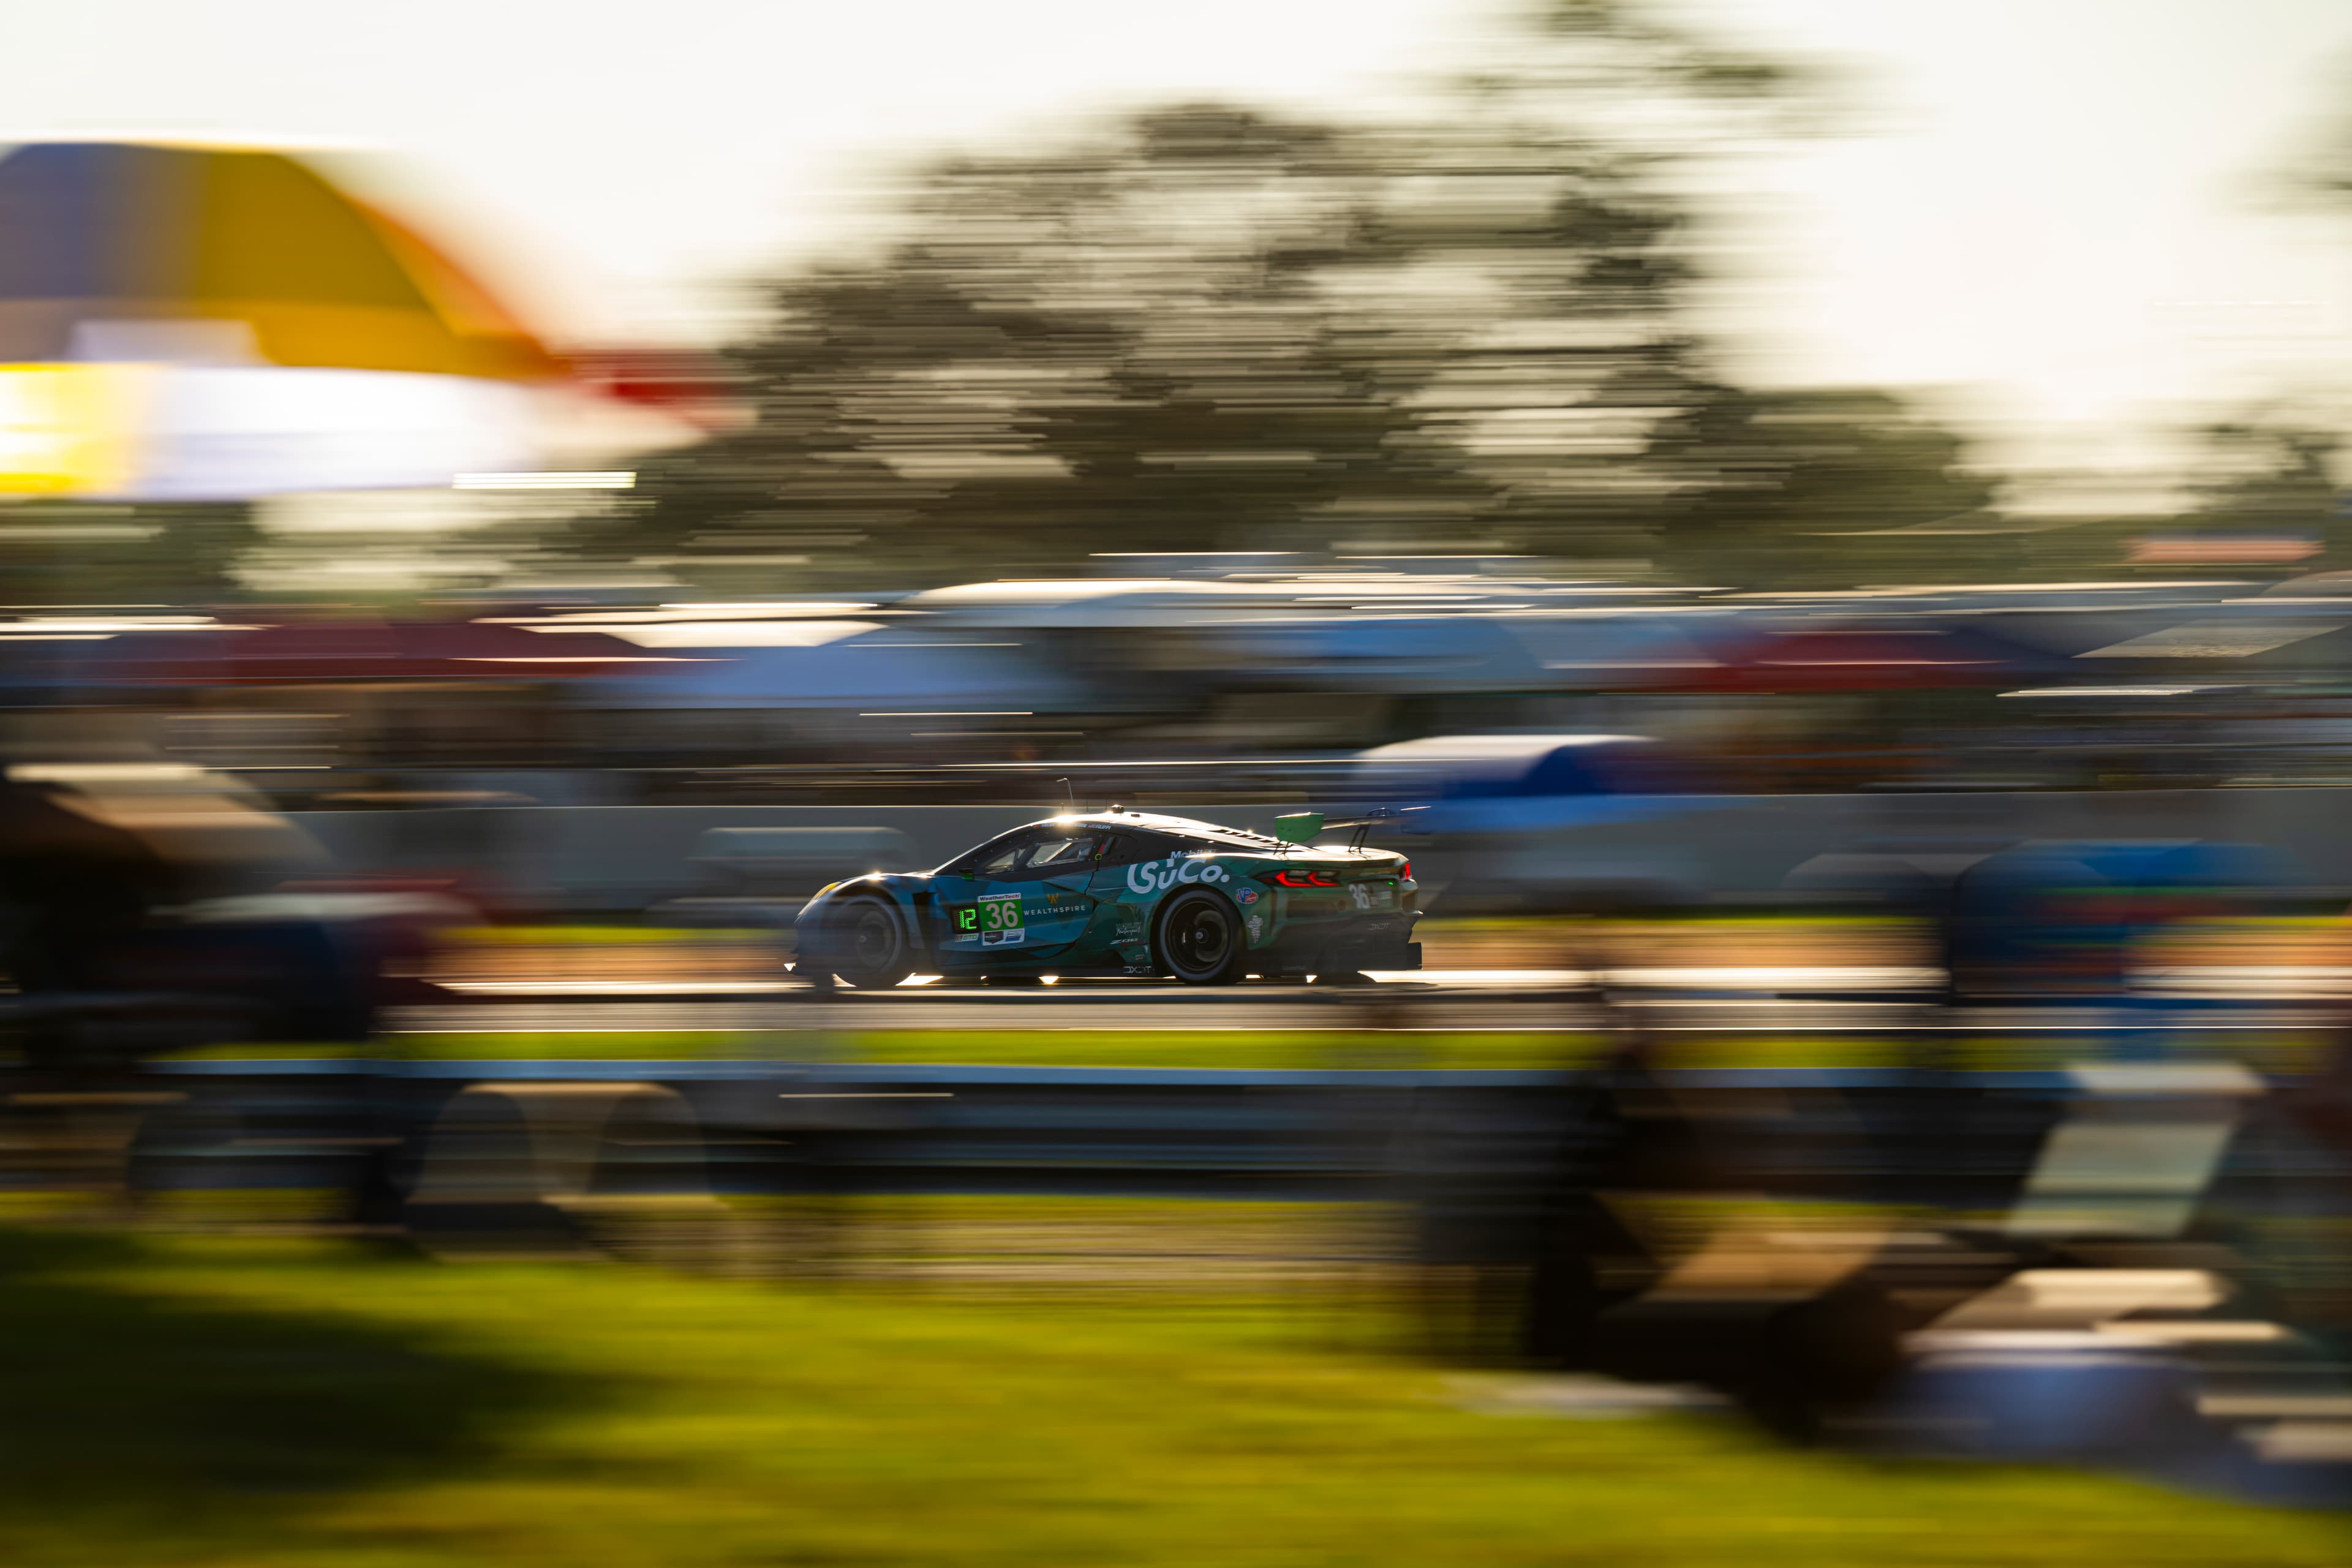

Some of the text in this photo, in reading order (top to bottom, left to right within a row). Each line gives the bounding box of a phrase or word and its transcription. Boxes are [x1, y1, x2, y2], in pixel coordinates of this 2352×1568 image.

[1349, 884, 1370, 909] 36
[985, 902, 1018, 929] 36
[1023, 905, 1087, 916] WEALTHSPIRE
